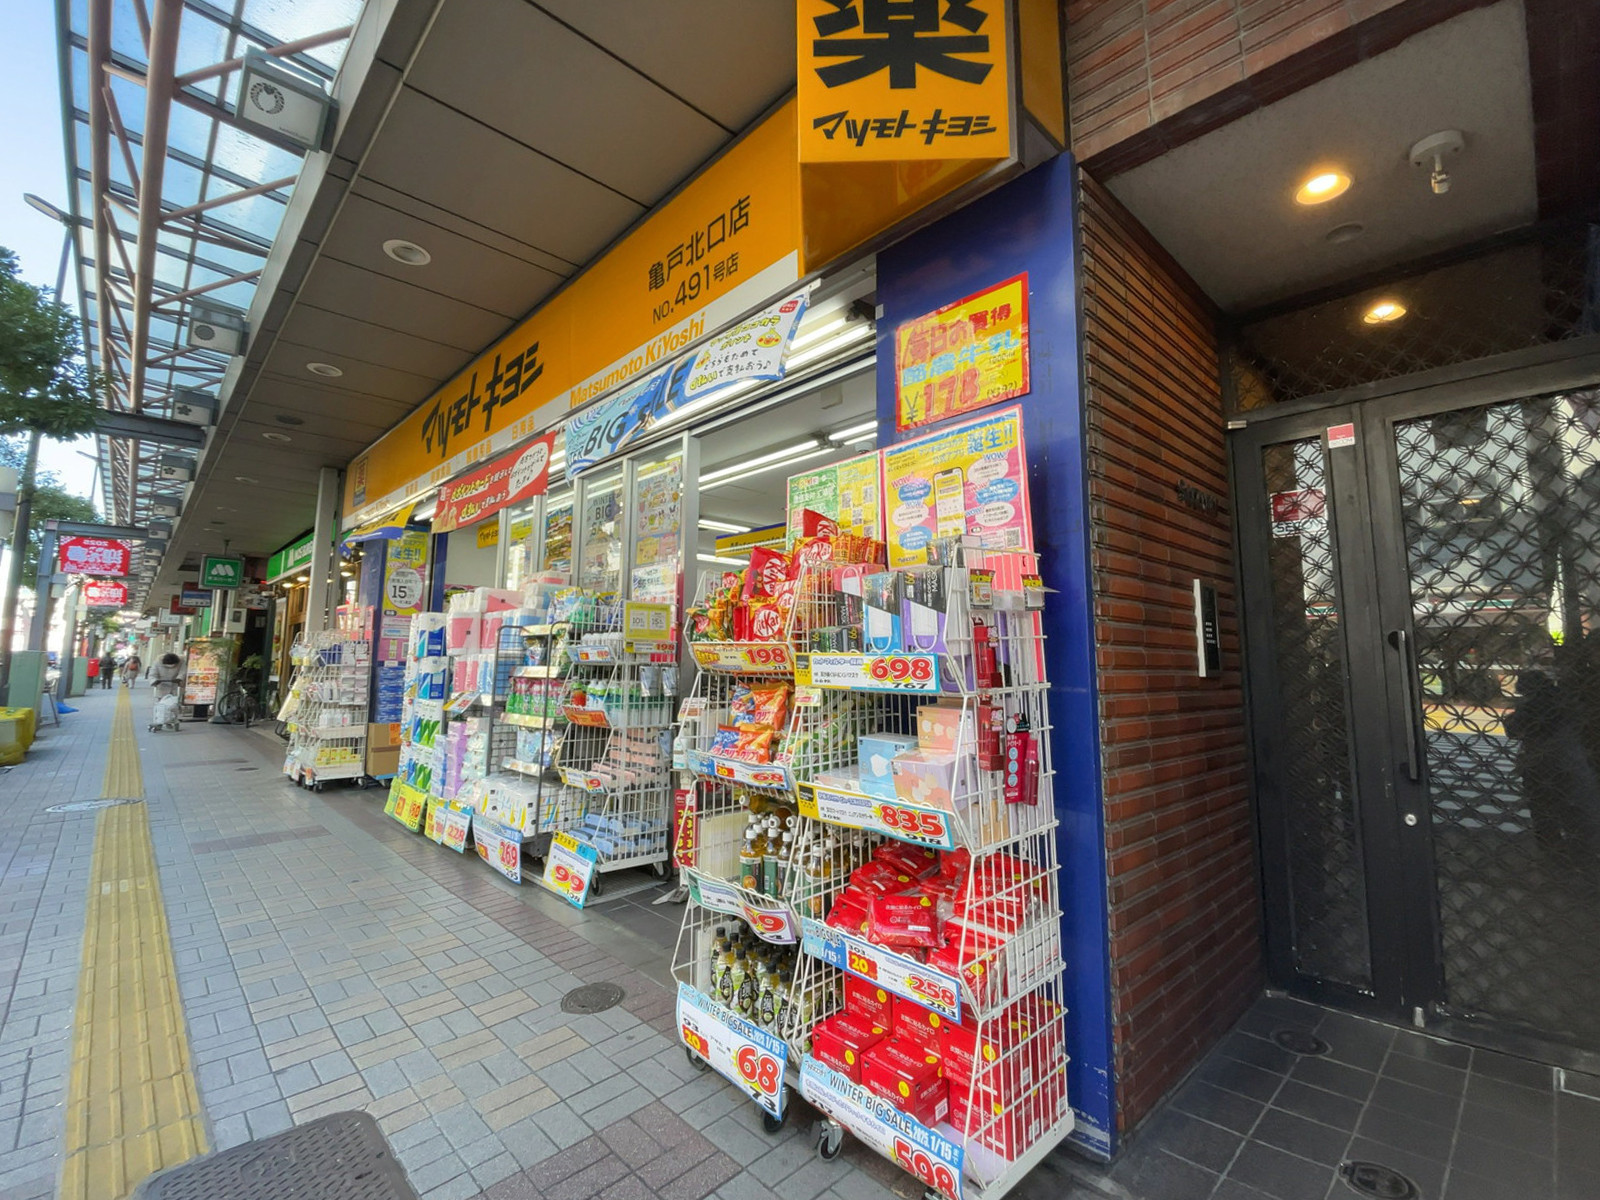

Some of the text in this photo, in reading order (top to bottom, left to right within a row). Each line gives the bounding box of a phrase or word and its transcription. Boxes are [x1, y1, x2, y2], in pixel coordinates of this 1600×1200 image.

[648, 195, 751, 292] 亀戸北口店
[570, 358, 643, 410] Matsumoto
[421, 341, 544, 459] マツモトキヨシ
[584, 411, 630, 458] BIG
[392, 585, 407, 598] 15
[747, 647, 786, 665] 198
[870, 658, 933, 681] 698
[752, 772, 784, 783] 68
[880, 803, 945, 837] 835
[500, 840, 518, 869] 269
[555, 865, 585, 893] 99
[850, 954, 869, 973] 20
[908, 975, 957, 1007] 258
[699, 998, 720, 1018] WINTER
[734, 1019, 752, 1038] SALE
[926, 999, 957, 1018] 283
[684, 1029, 700, 1050] 20
[738, 1045, 779, 1096] 68
[750, 1086, 777, 1113] 73
[829, 1073, 864, 1103] WINTER
[865, 1095, 884, 1117] BIG
[885, 1109, 911, 1135] SALE
[931, 1136, 952, 1161] 1/15
[894, 1136, 958, 1200] 598
